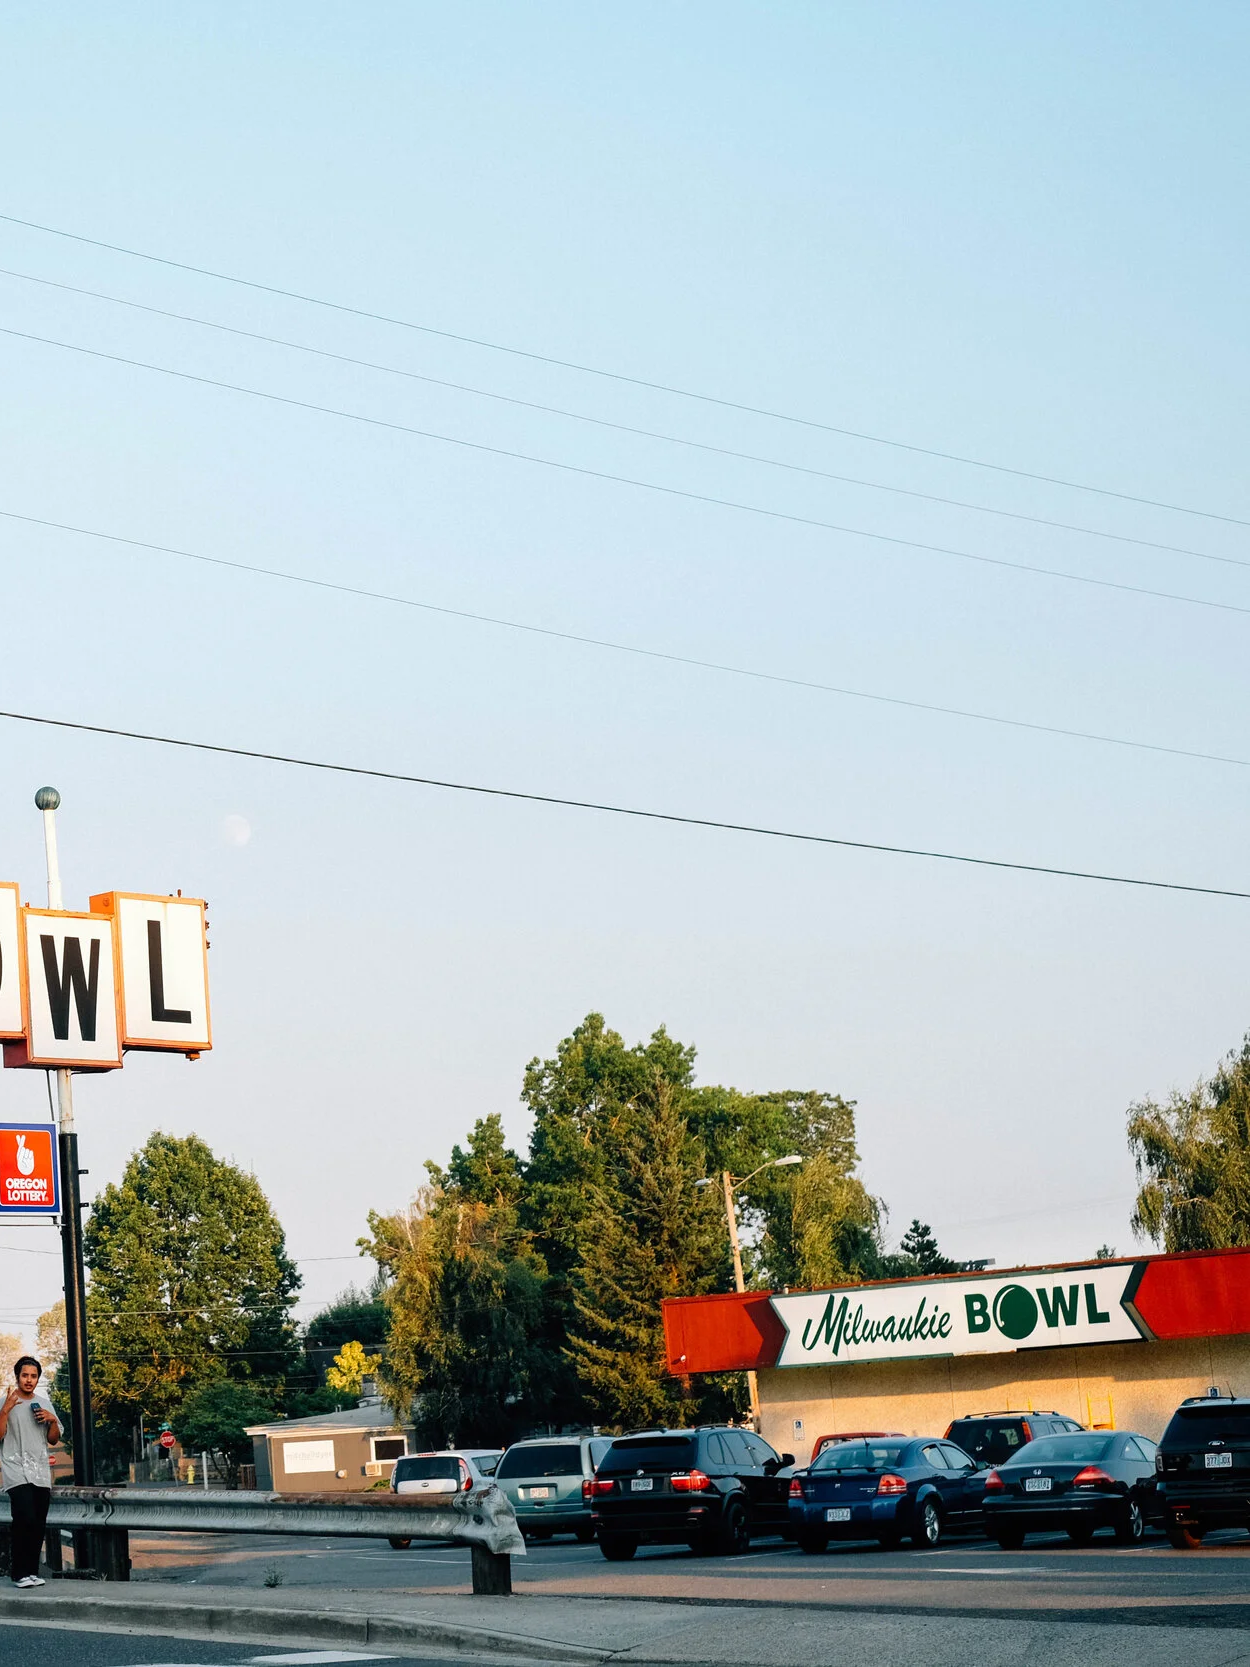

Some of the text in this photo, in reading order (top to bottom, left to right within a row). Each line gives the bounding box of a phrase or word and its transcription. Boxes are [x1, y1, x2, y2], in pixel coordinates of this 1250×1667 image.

[5, 1177, 48, 1190] OREGON
[7, 1190, 48, 1202] LOTTERY
[801, 1283, 1111, 1357] Milwaukie BOWL
